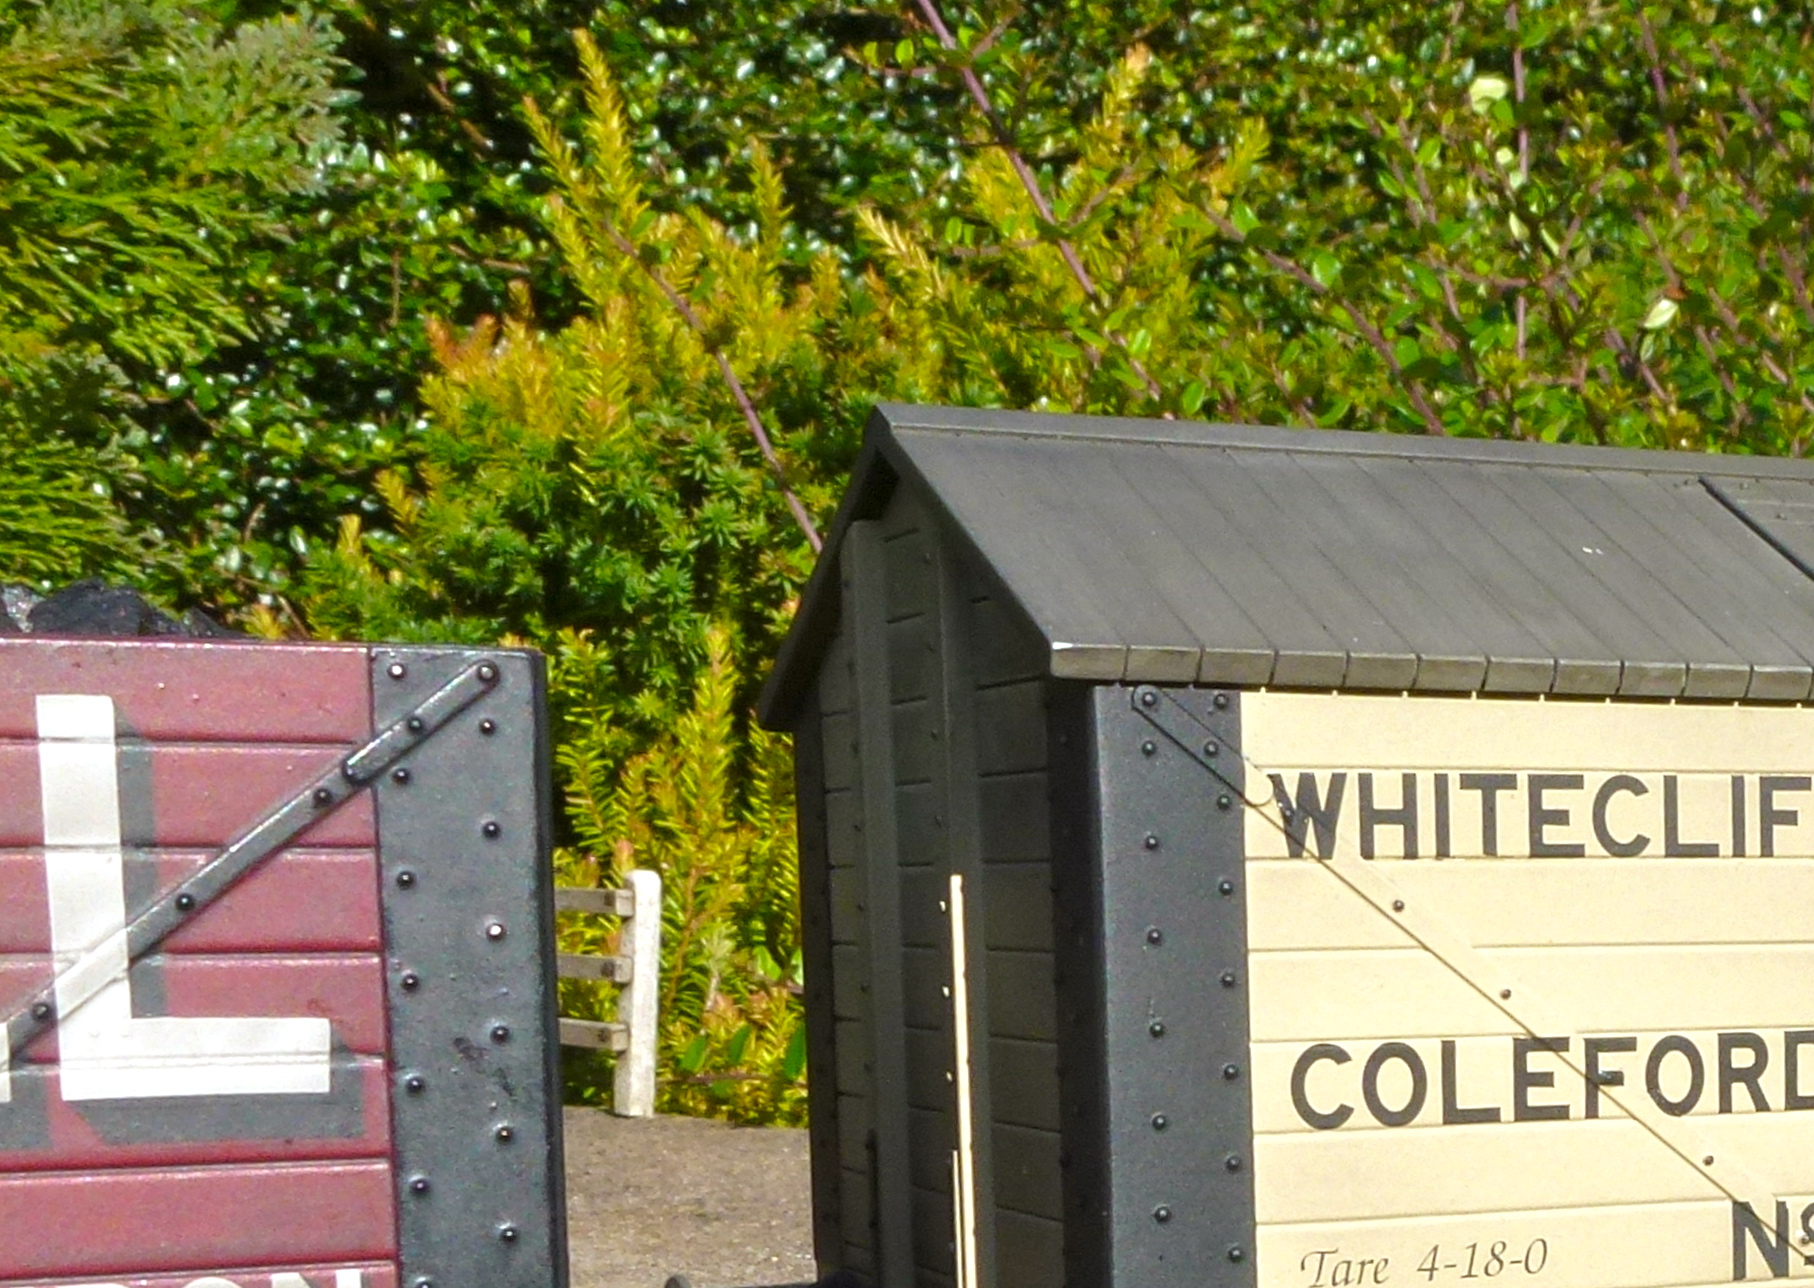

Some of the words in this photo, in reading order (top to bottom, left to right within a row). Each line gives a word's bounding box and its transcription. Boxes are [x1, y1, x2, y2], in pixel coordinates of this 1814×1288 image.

[0, 694, 331, 1102] L
[1300, 1247, 1391, 1288] Tare
[1416, 1238, 1548, 1282] 4-18-0
